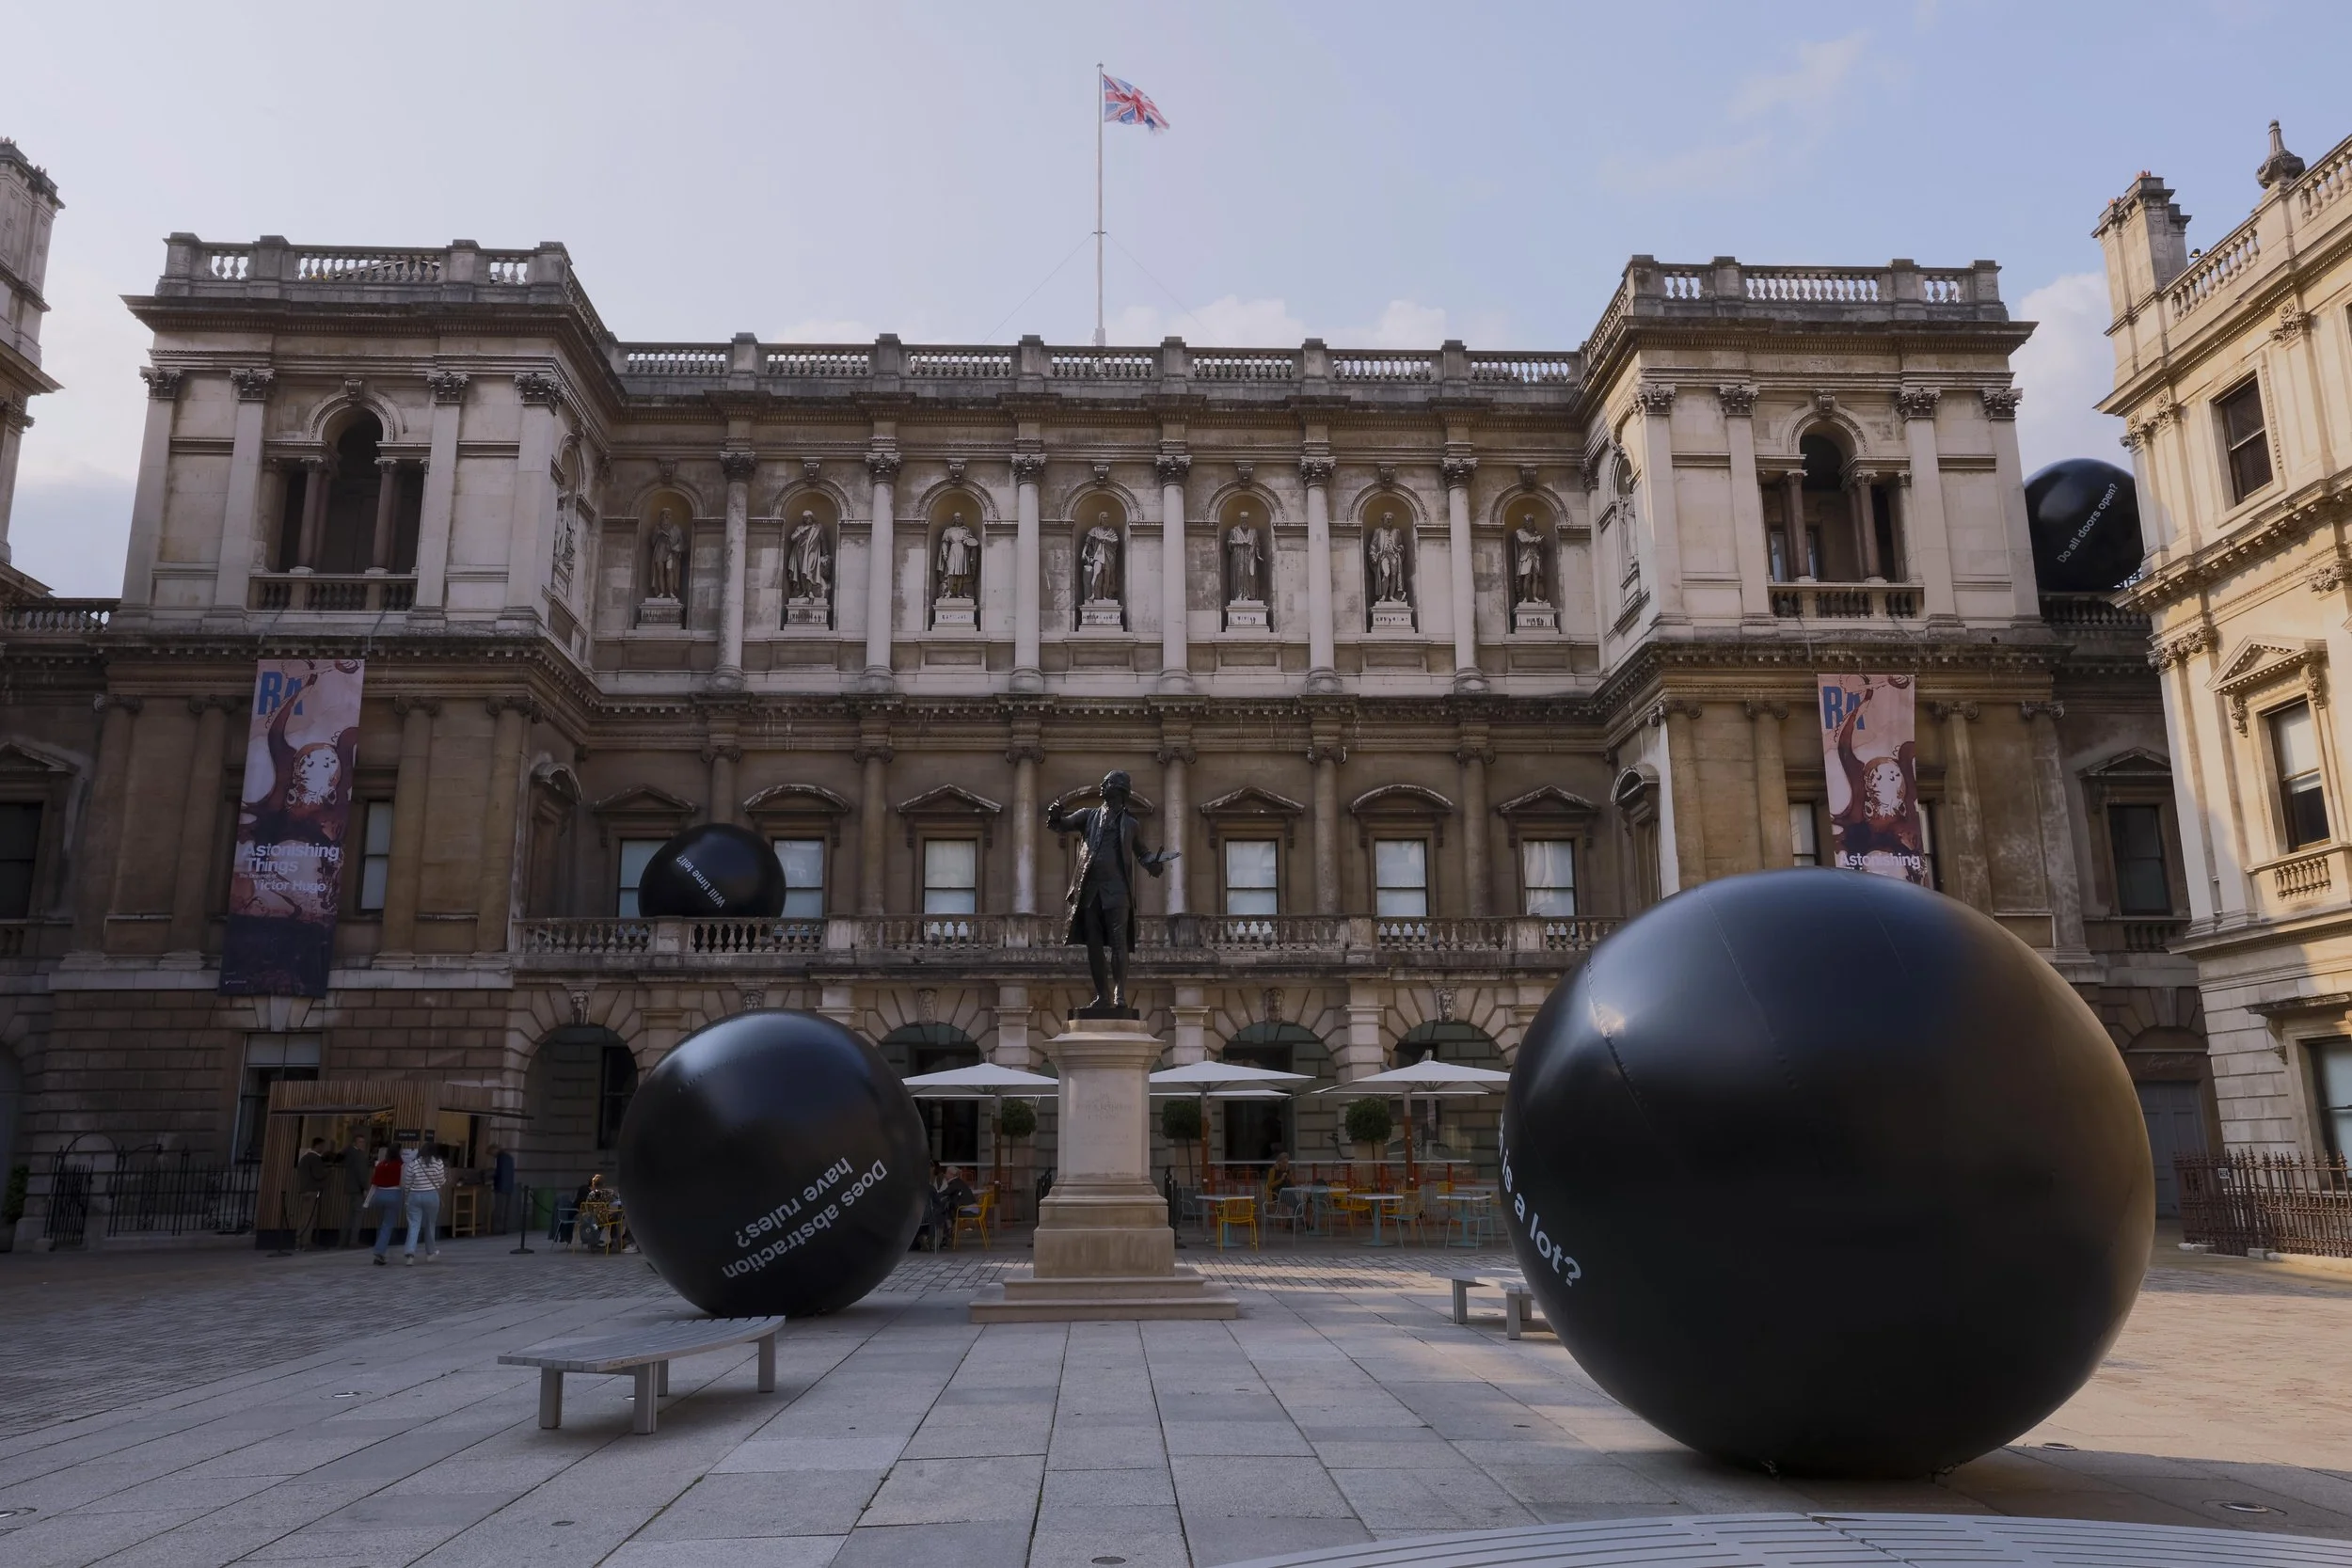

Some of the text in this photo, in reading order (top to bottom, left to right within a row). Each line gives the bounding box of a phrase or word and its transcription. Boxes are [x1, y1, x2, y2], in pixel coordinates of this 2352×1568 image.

[2057, 483, 2119, 563] Do all doors open?
[257, 671, 303, 716] RA
[1823, 686, 1866, 731] RA
[241, 842, 340, 861] Astonishing
[245, 857, 299, 875] Things
[1839, 852, 1922, 870] Astonishing
[253, 879, 326, 895] Victor Hugo
[676, 854, 725, 909] Will time tell?
[722, 1159, 888, 1278] Does abstraction
[735, 1157, 854, 1248] have rules?
[1502, 1148, 1581, 1288] is a lot?
